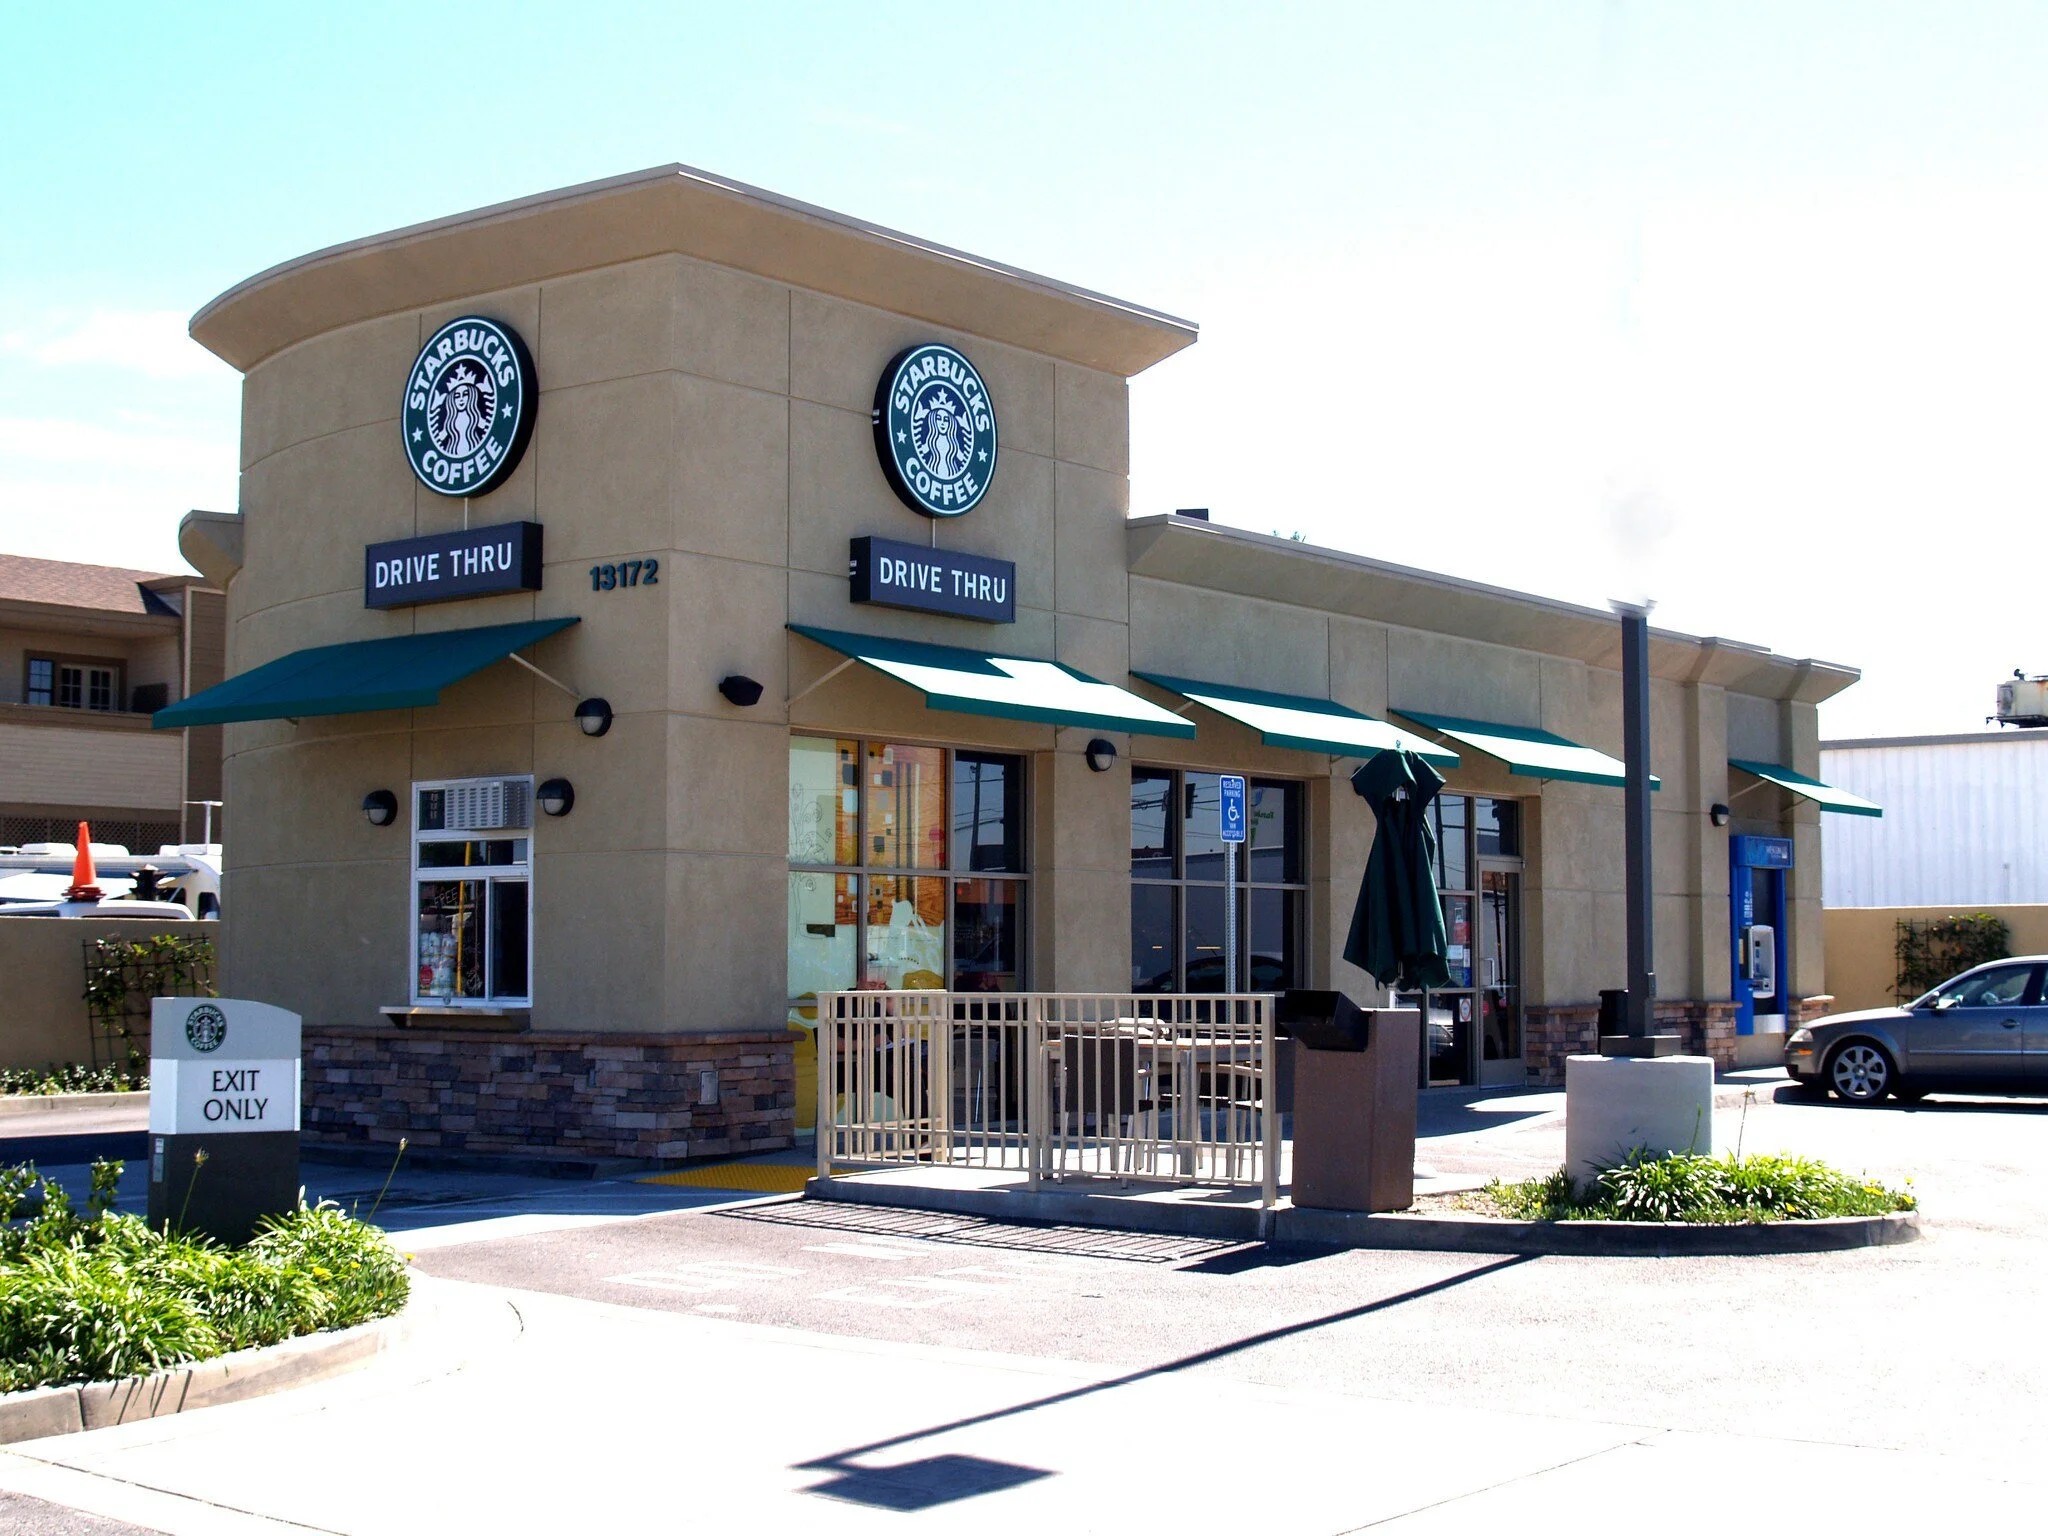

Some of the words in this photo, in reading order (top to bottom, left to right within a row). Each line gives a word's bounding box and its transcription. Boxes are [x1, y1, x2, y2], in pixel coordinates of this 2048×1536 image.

[410, 328, 514, 411] STARBUCKS
[895, 355, 990, 434] STARBUCKS
[421, 435, 503, 485] COFFEE
[905, 456, 979, 505] COFFEE
[374, 552, 440, 589] DRIVE
[449, 541, 513, 578] THRU
[589, 558, 659, 592] 13172
[879, 556, 943, 593] DRIVE
[951, 569, 1007, 604] THRU
[188, 1006, 224, 1027] STARBUCKS
[190, 1037, 219, 1050] COFFEE
[212, 1070, 260, 1092] EXIT
[203, 1098, 269, 1121] ONLY
